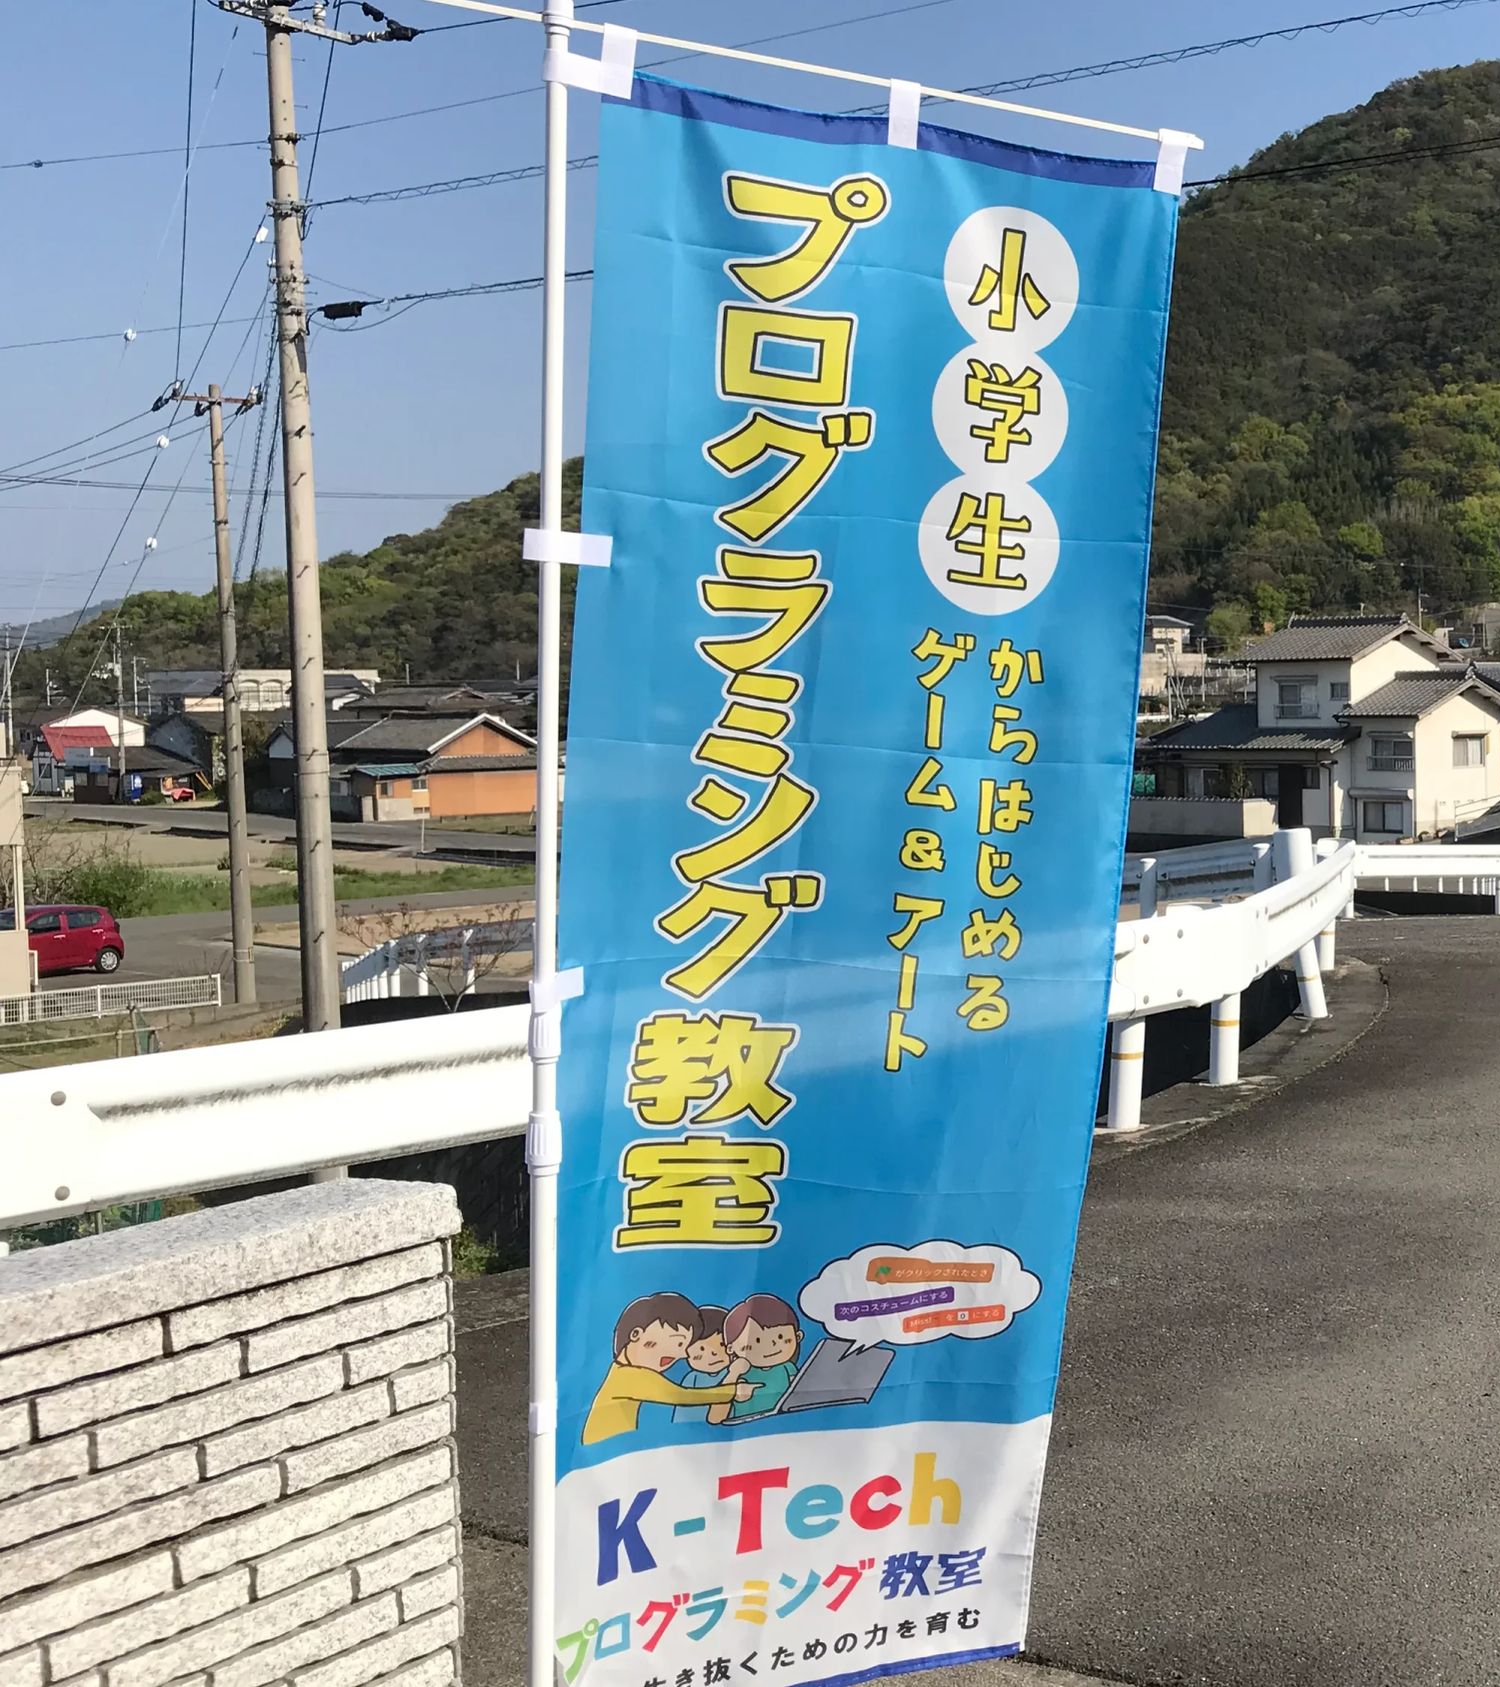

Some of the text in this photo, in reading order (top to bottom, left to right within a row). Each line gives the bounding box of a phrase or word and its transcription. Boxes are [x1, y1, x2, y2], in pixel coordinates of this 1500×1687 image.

[945, 227, 1052, 591] 小学生
[615, 172, 888, 1249] プログラミング教室
[883, 627, 977, 1072] ゲーム&アート
[955, 638, 1044, 1032] からはじめる
[839, 1290, 949, 1316] 次のコスチュームにする
[554, 1546, 987, 1685] プログラミング教室
[596, 1451, 962, 1587] K-Tech
